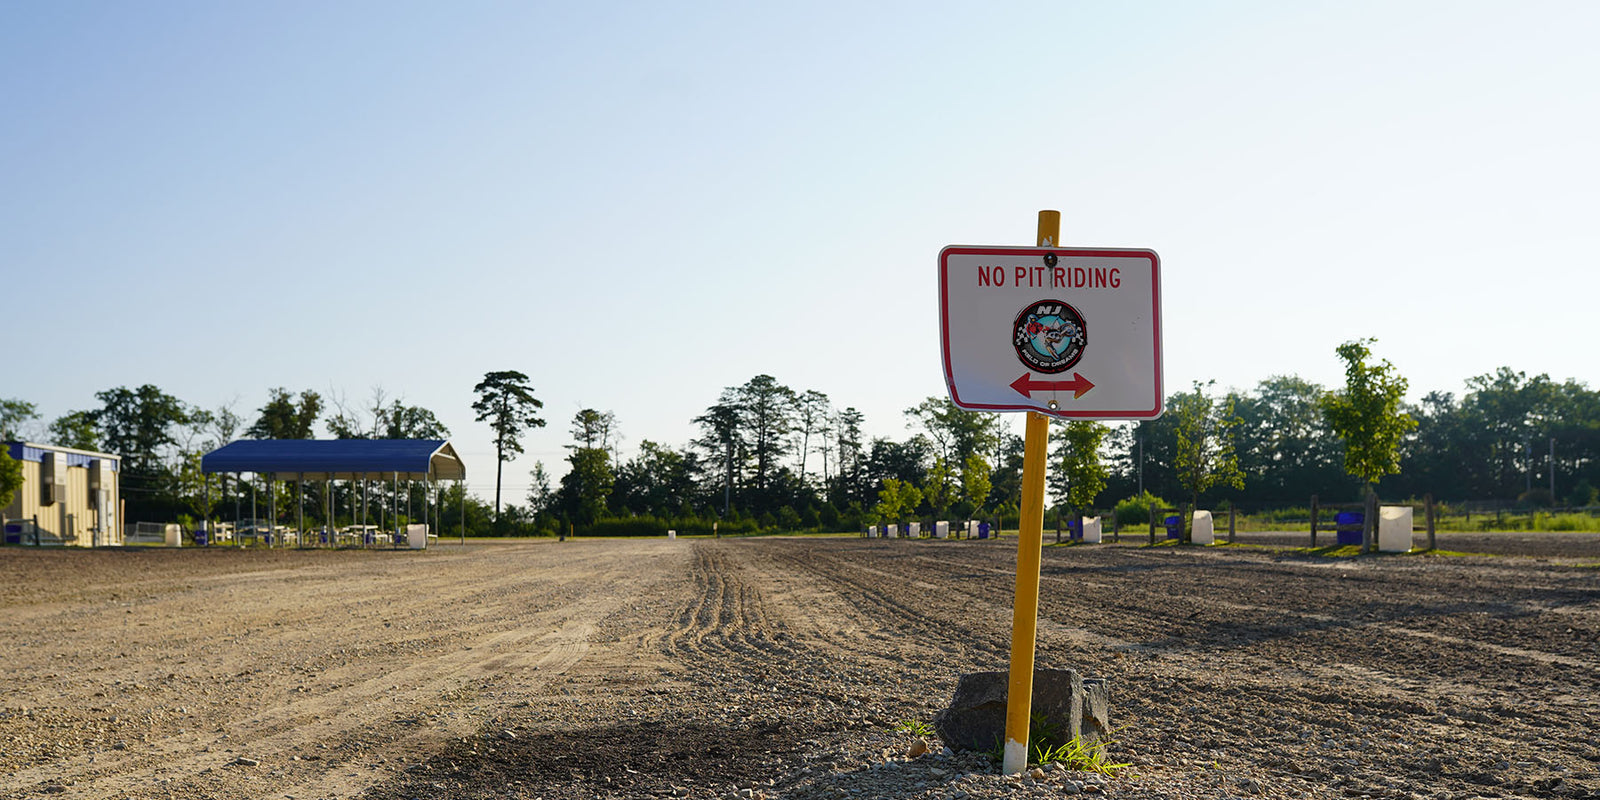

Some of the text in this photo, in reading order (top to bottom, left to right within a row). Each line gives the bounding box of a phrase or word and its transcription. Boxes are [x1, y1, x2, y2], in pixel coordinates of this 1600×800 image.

[978, 266, 1121, 288] NO PIT RIDING
[1036, 305, 1062, 315] NJ
